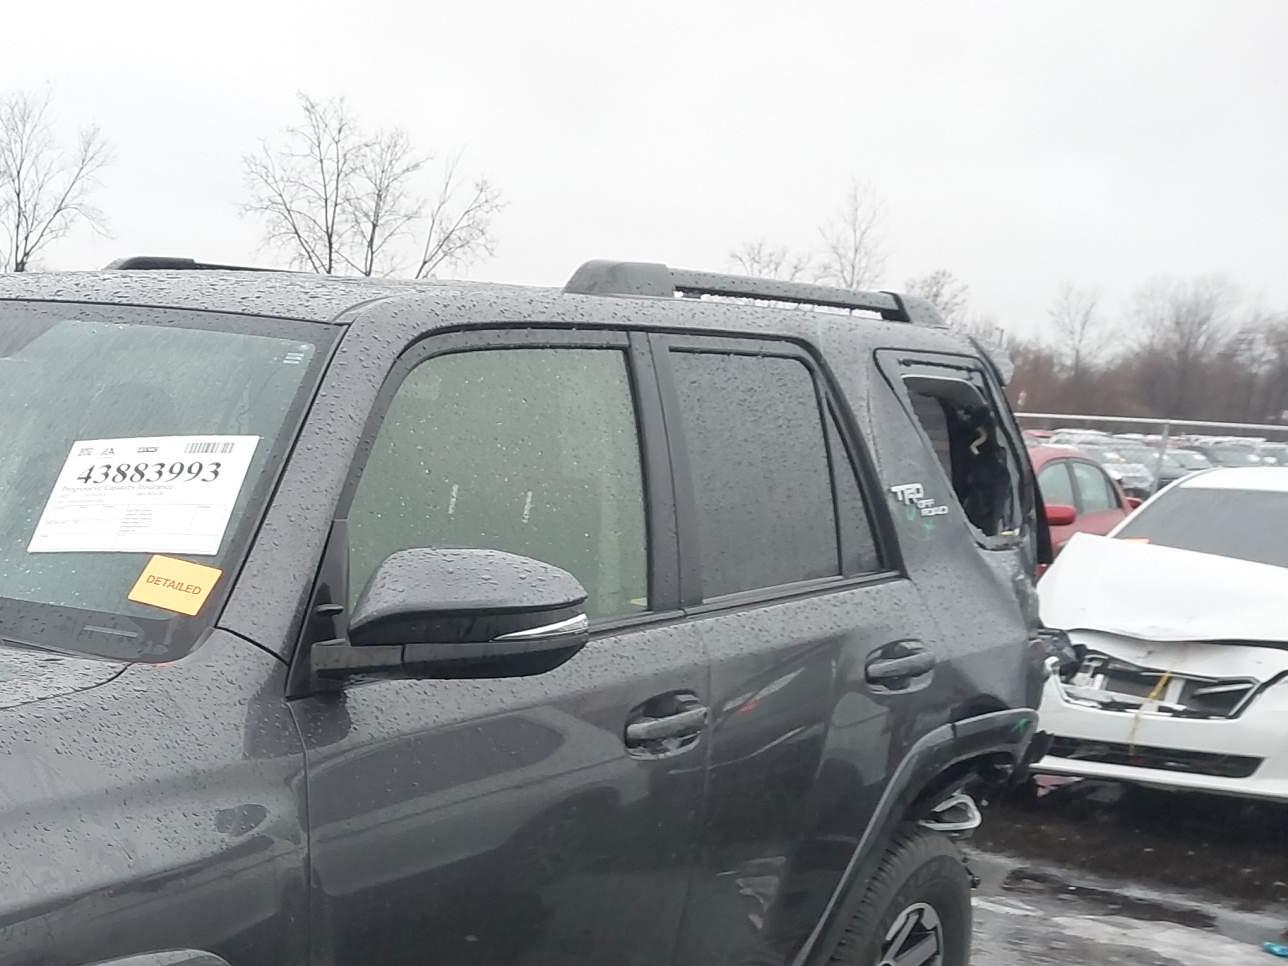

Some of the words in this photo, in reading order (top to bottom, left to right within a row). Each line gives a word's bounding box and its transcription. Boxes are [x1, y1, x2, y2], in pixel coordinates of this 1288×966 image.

[76, 461, 222, 484] 43883993
[890, 483, 924, 505] TRD
[146, 574, 202, 596] DETAILED
